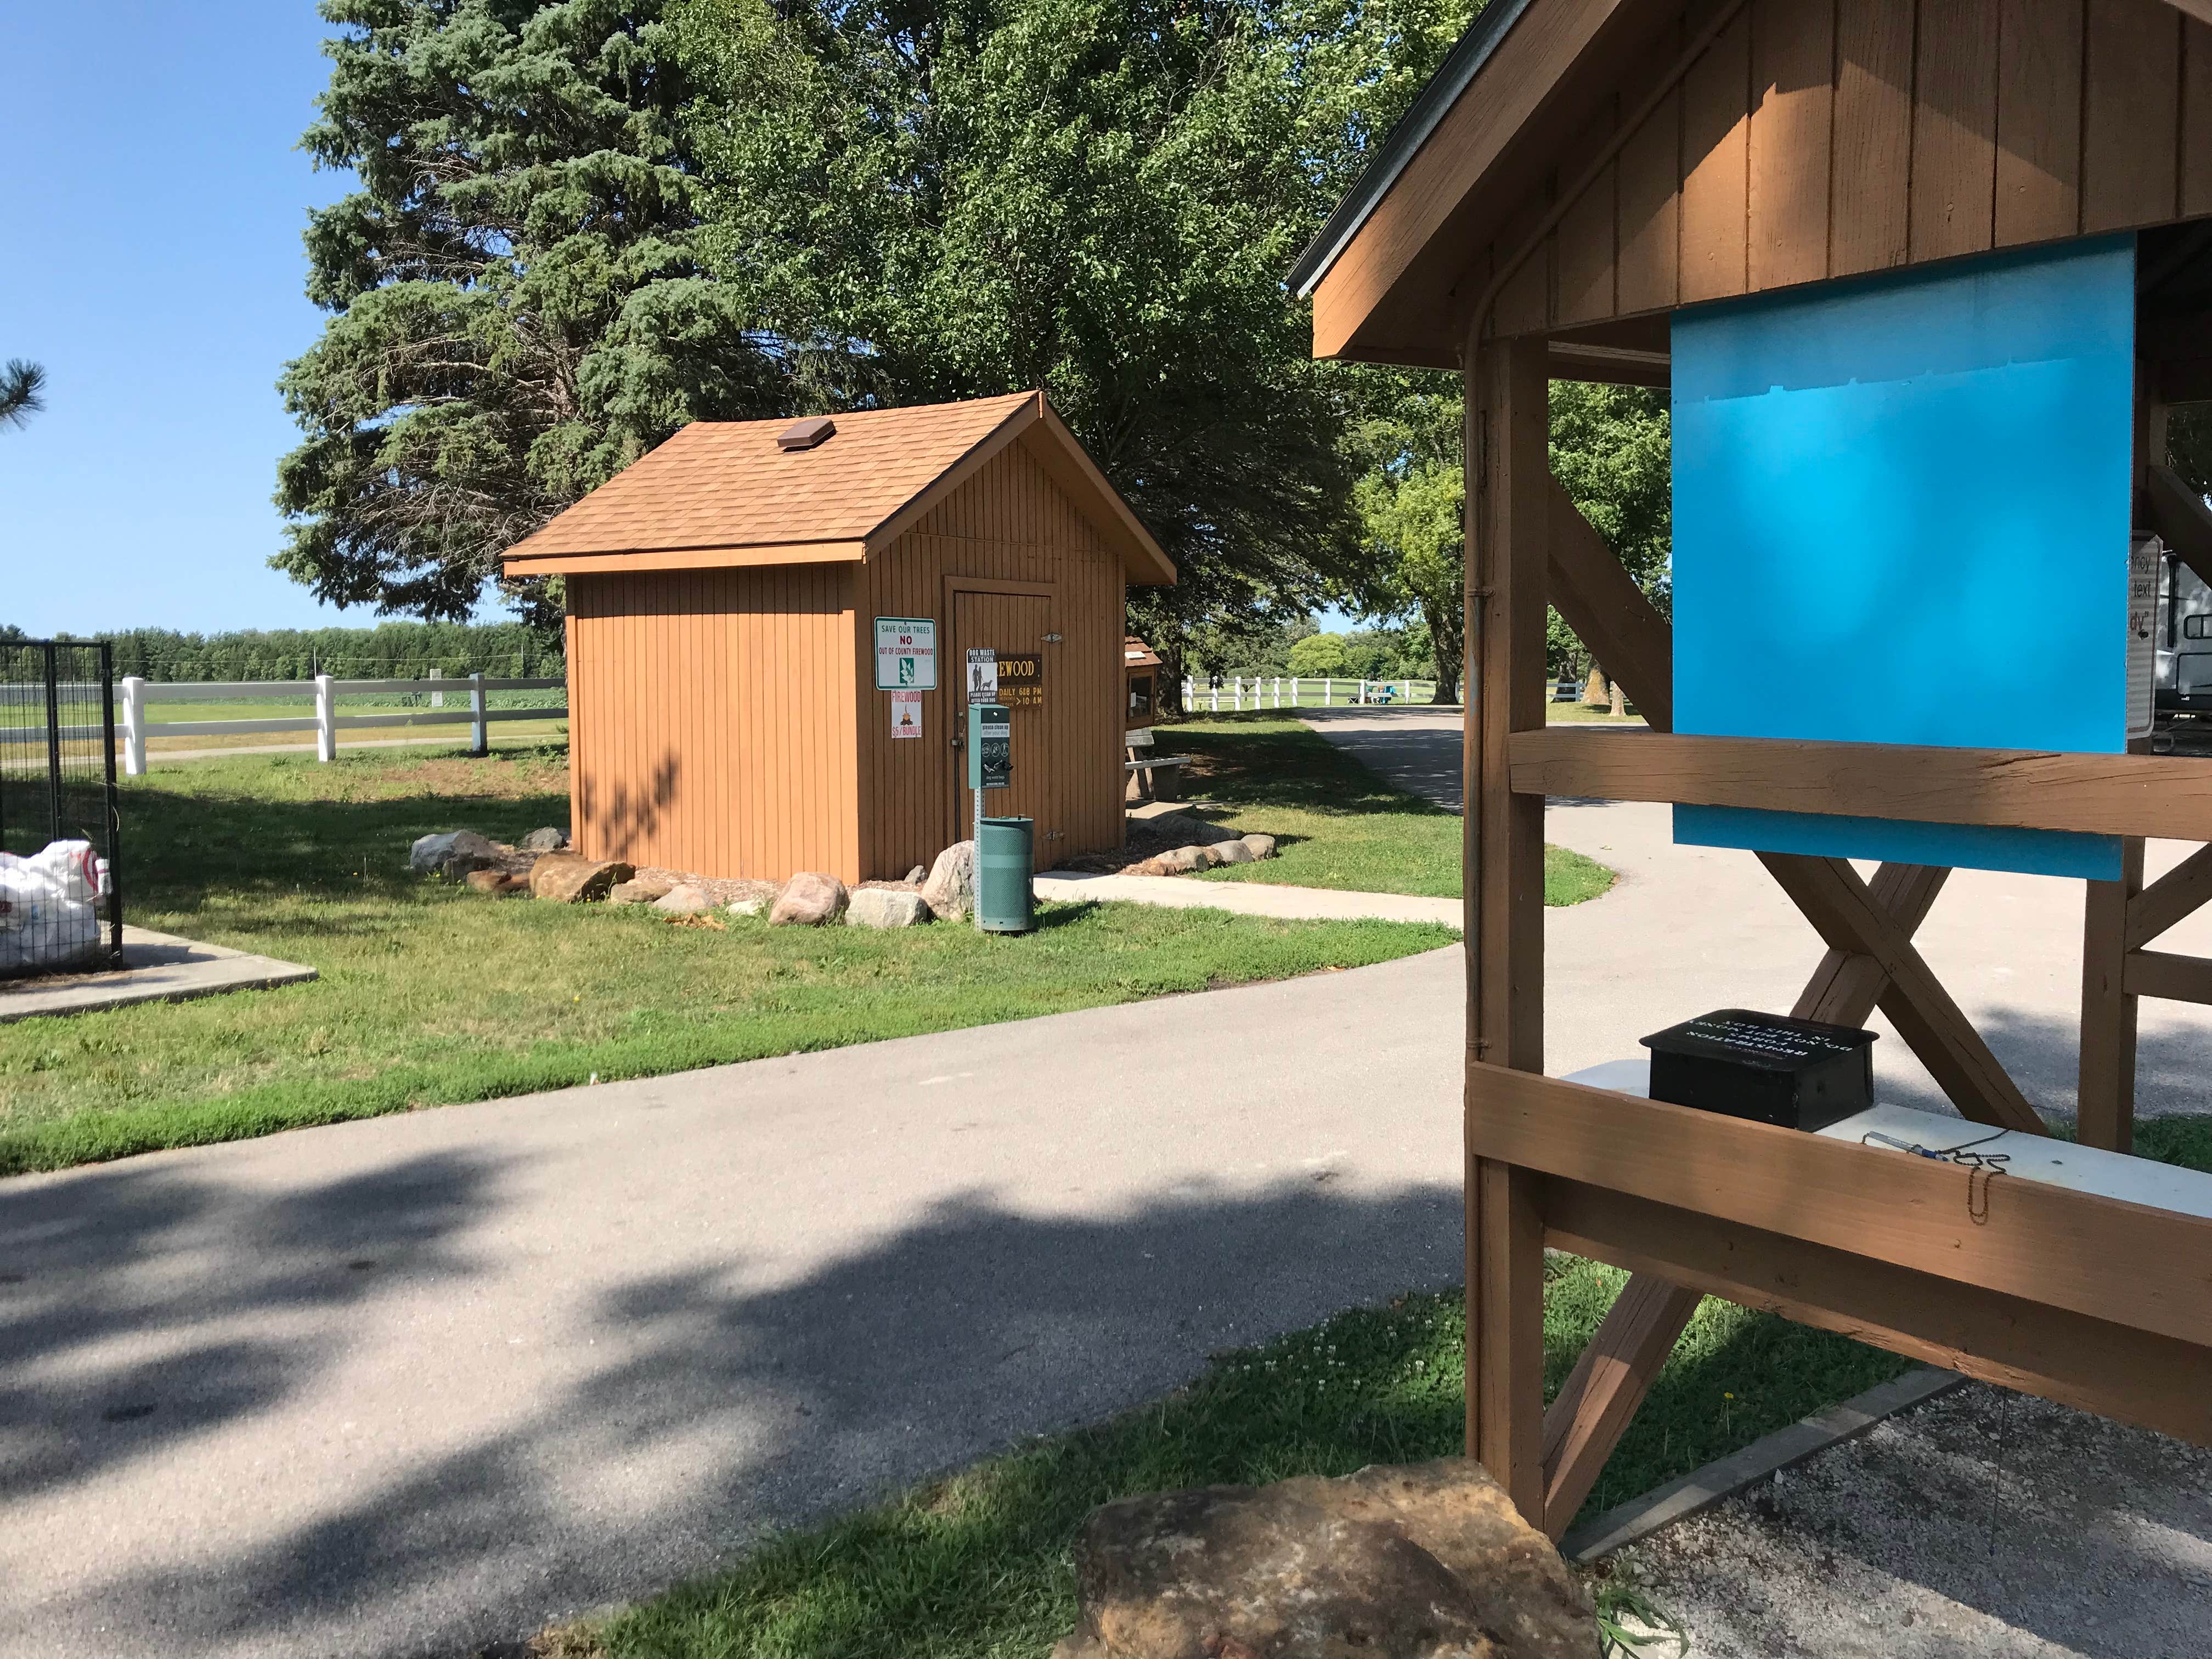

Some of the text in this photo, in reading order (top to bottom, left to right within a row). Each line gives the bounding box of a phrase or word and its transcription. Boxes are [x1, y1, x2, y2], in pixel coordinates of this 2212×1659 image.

[2134, 581, 2151, 597] text
[900, 635, 912, 645] NO
[997, 661, 1034, 676] EWOOD
[892, 691, 921, 702] FIREWOOD
[1033, 687, 1042, 695] PM
[1689, 1020, 1742, 1031] MONEY
[1723, 1021, 1759, 1029] BOX
[1765, 1028, 1802, 1036] THIS
[1686, 1031, 1808, 1056] REGISTRATION
[1728, 1032, 1788, 1046] FORMS
[1784, 1037, 1819, 1045] NOT
